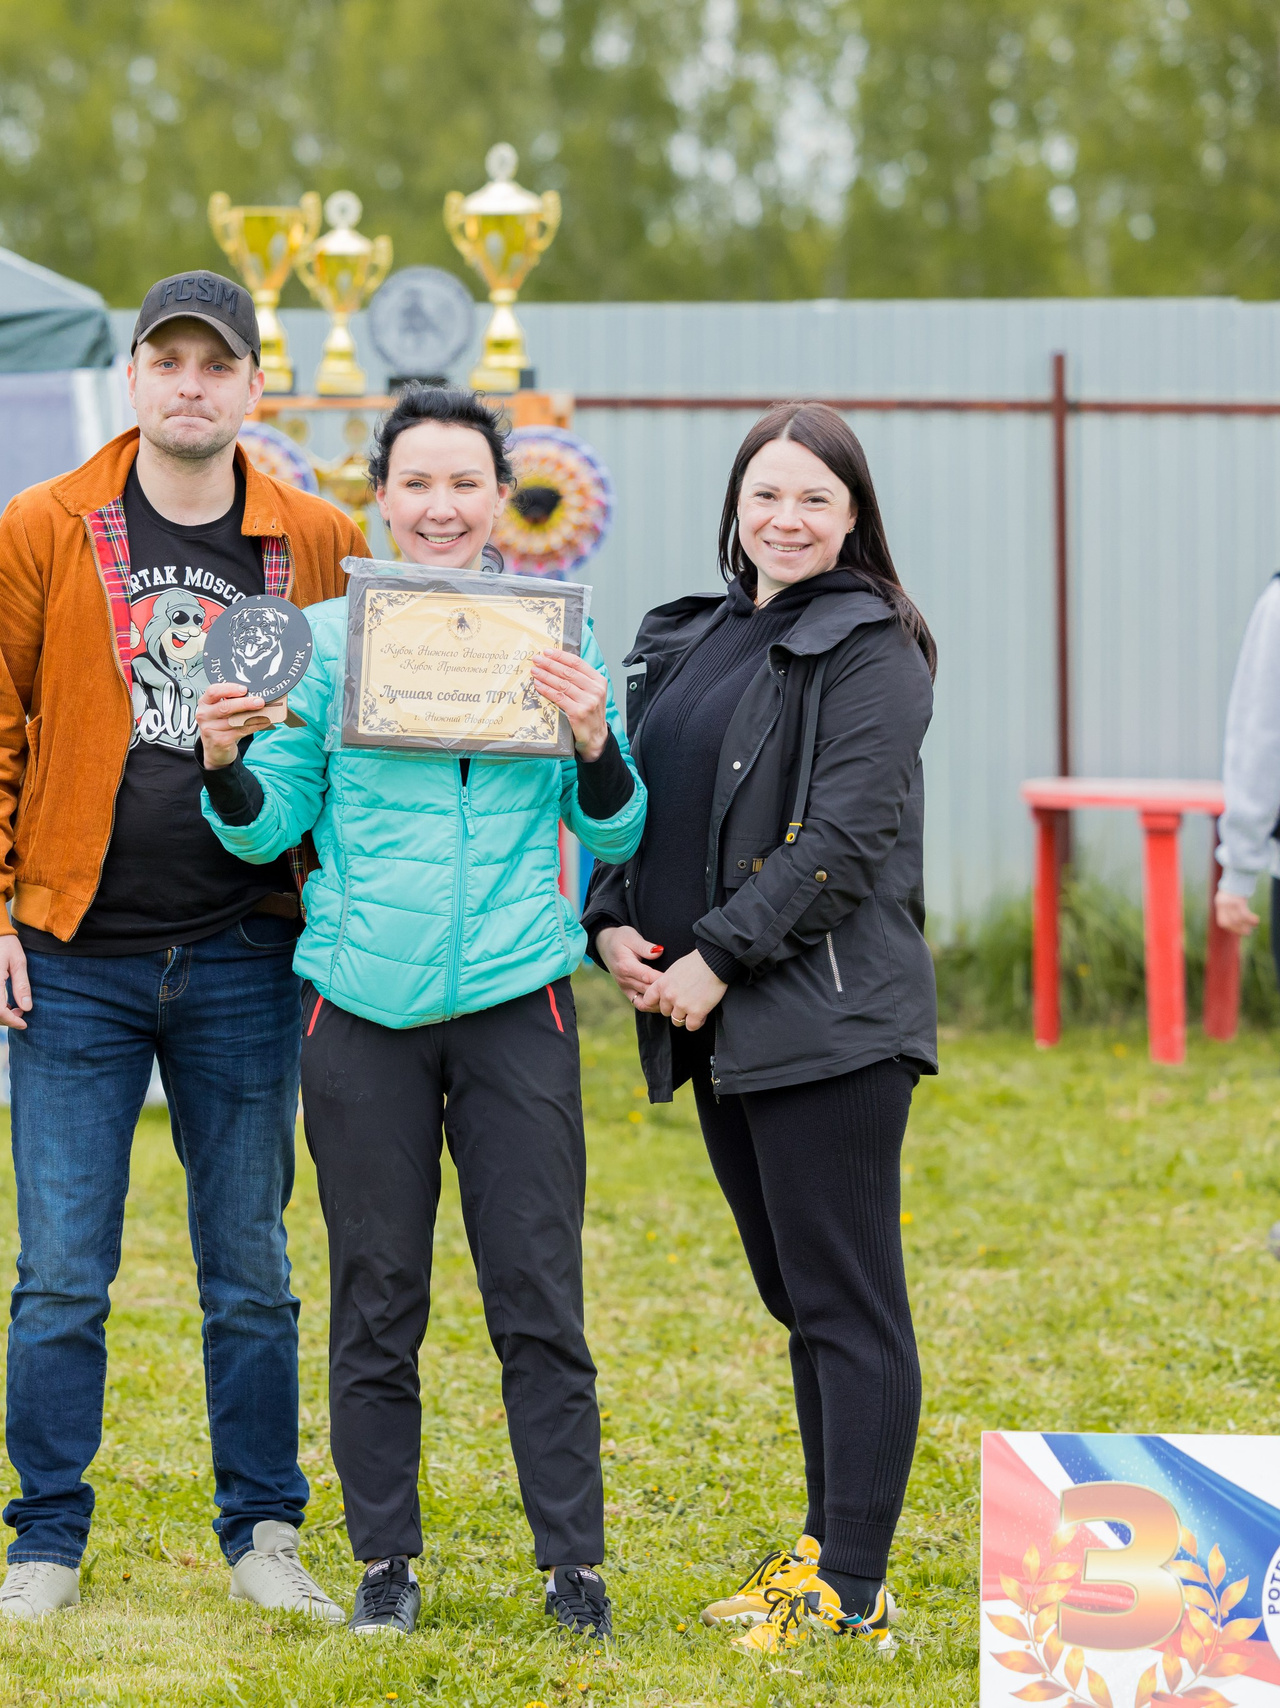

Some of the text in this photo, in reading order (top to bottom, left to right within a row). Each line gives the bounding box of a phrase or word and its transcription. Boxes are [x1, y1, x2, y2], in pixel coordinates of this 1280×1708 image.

[161, 277, 239, 315] FCSM
[130, 566, 178, 595] RTAK
[417, 644, 458, 658] Нижнего
[463, 647, 508, 663] Новгорода
[288, 650, 306, 678] ПРК
[436, 661, 487, 676] Приволжья
[379, 685, 517, 705] Лучшая собака ПРК
[424, 711, 461, 723] Нижний
[464, 713, 503, 727] Новгород
[370, 1562, 389, 1574] adidas
[1057, 1482, 1186, 1652] 3
